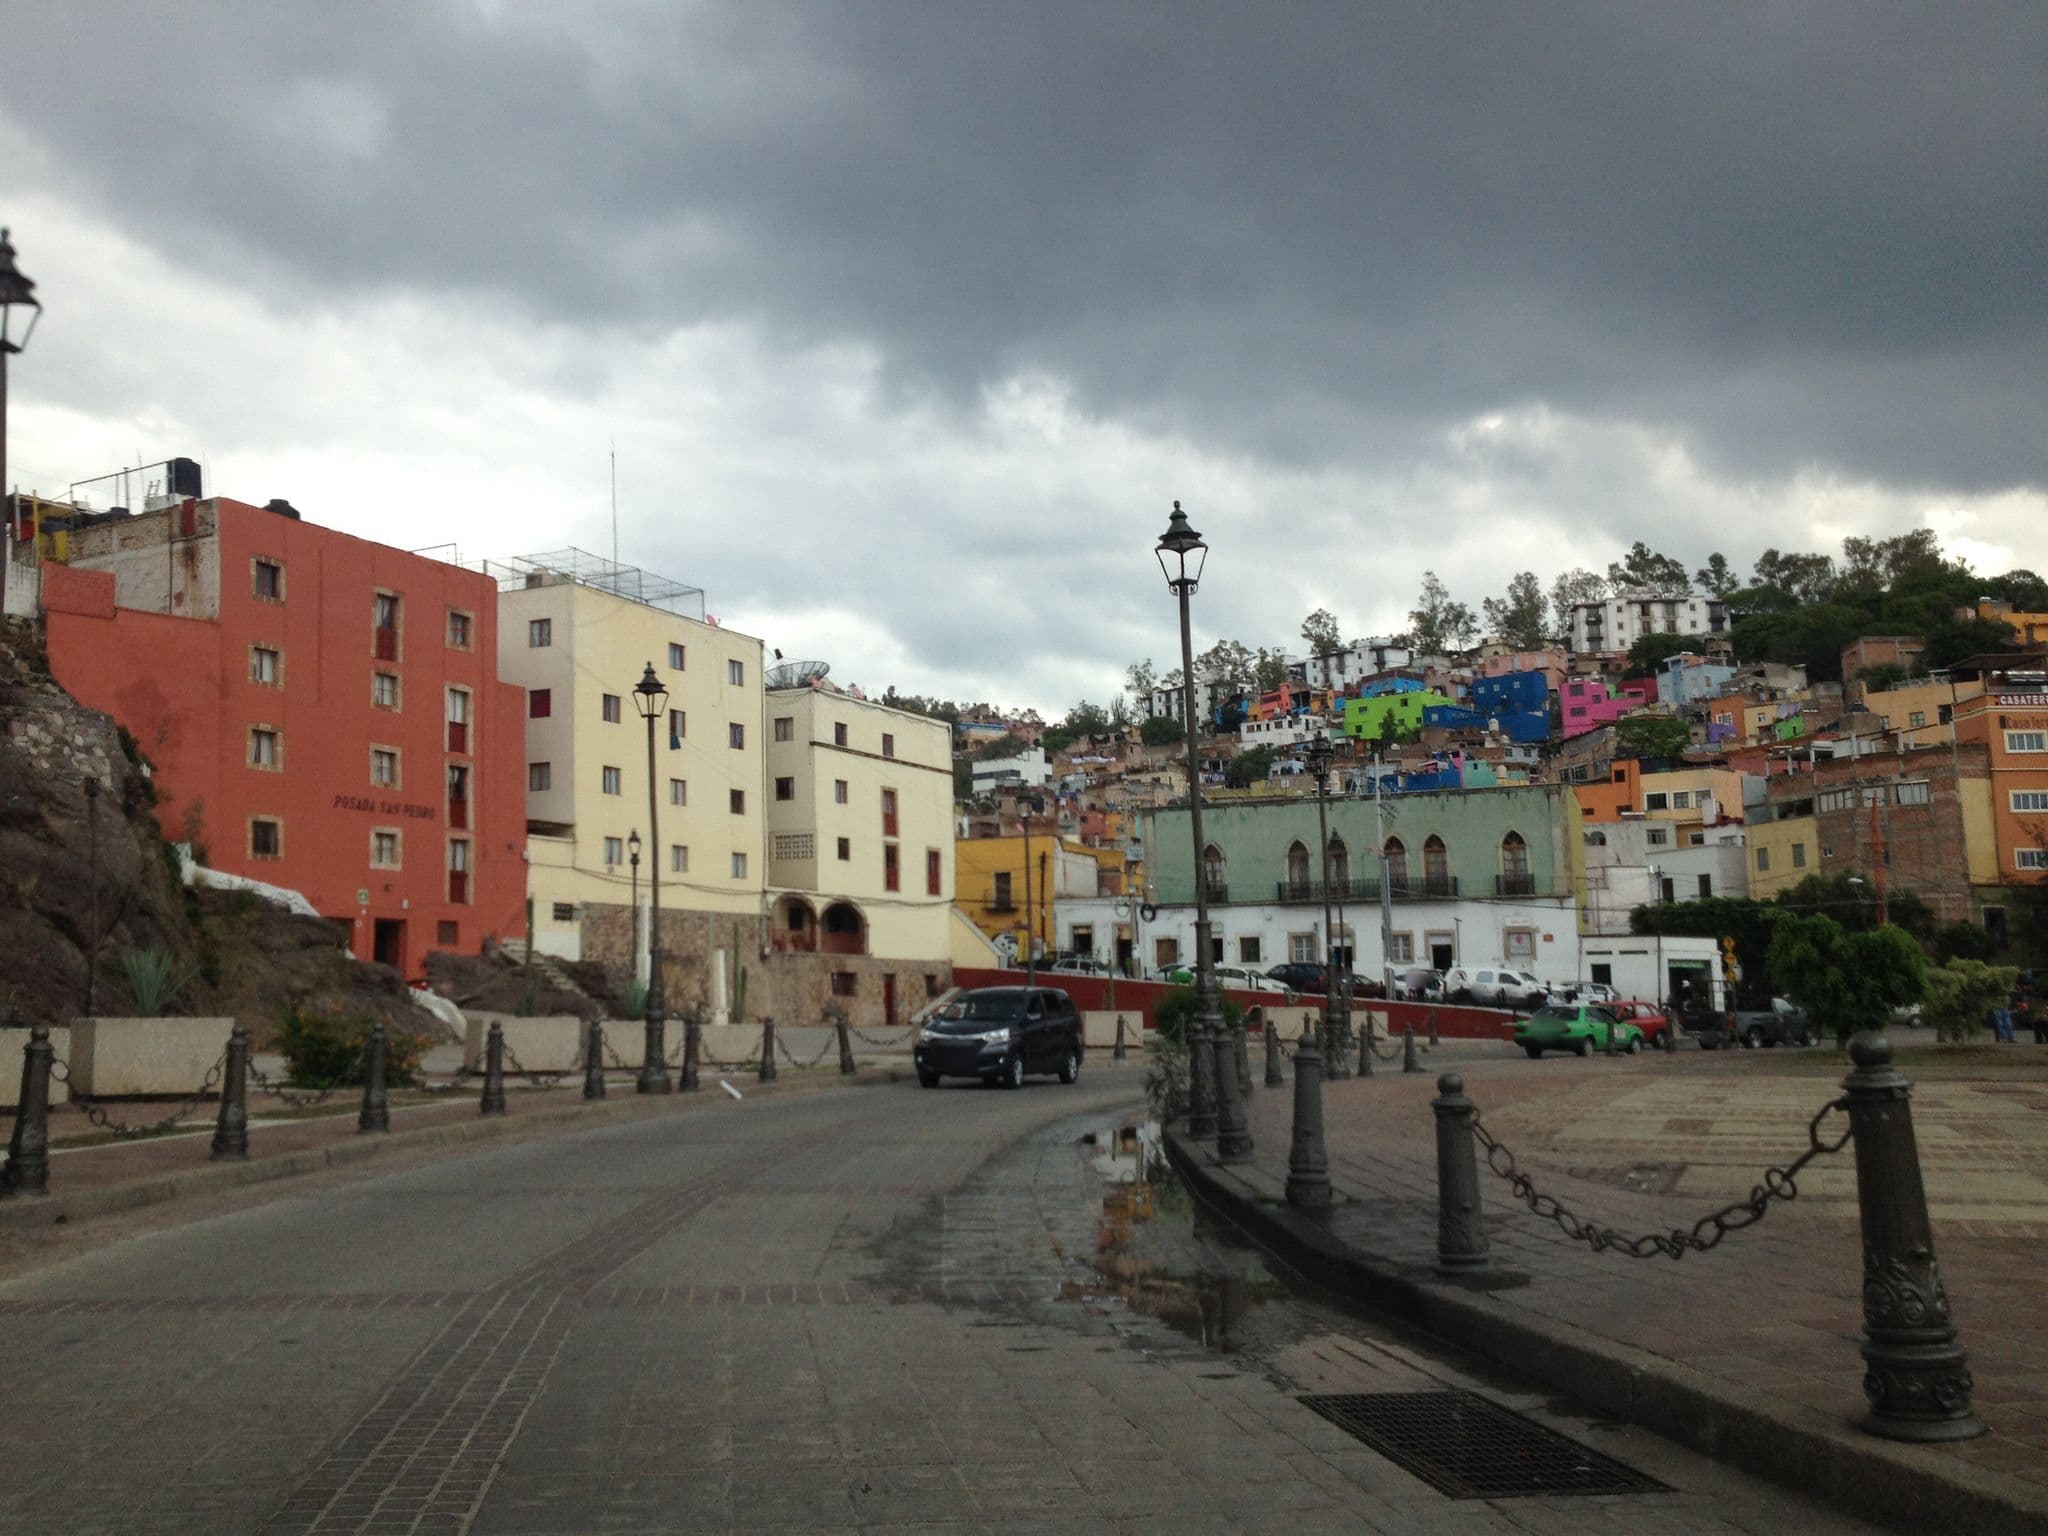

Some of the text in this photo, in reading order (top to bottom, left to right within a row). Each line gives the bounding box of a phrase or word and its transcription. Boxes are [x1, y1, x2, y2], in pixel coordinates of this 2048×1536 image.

[334, 795, 435, 819] POSADA SAN PEDRO
